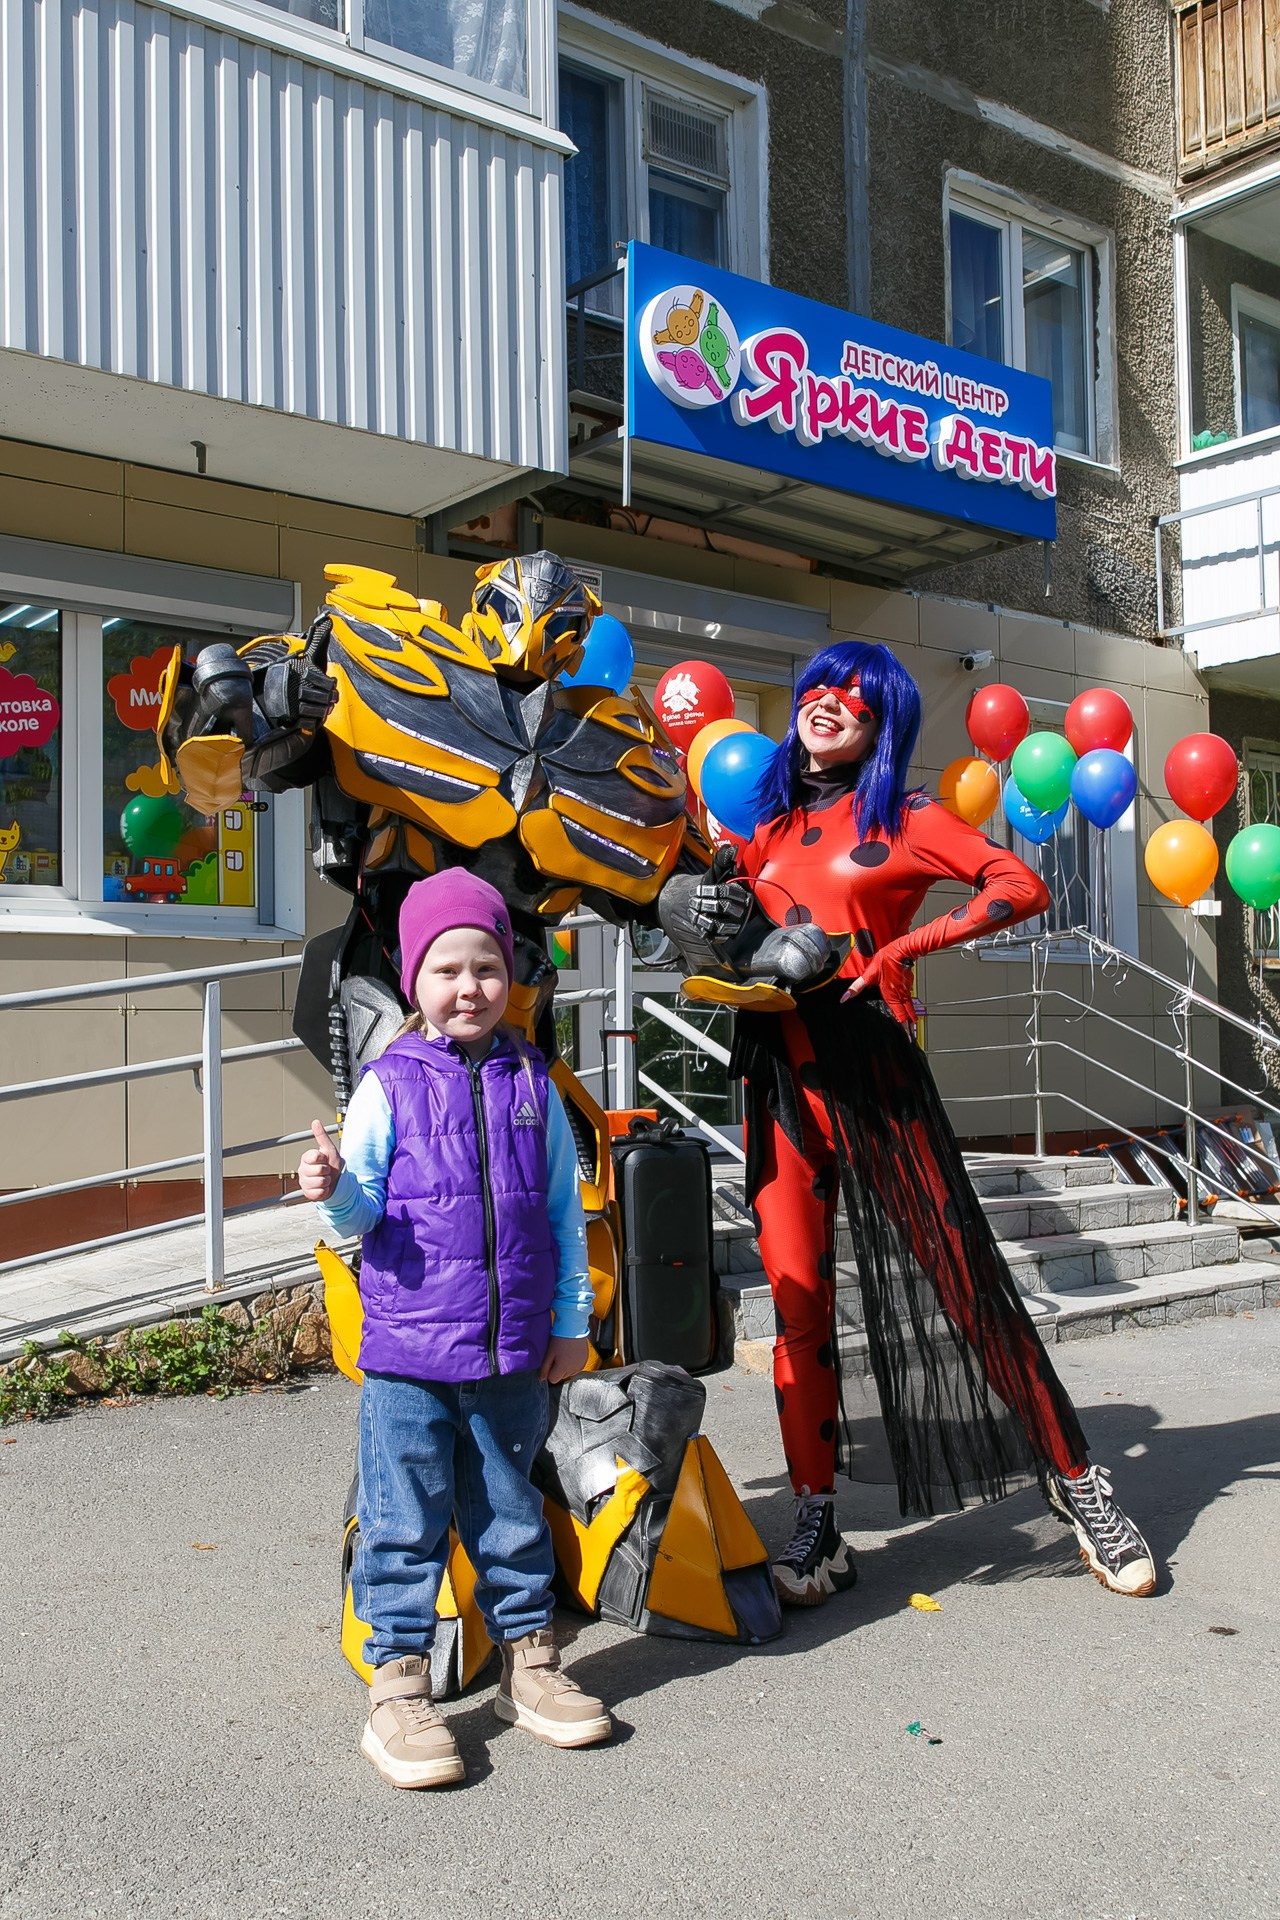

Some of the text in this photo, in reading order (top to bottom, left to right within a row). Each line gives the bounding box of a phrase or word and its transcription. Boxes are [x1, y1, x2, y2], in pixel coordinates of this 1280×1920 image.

[842, 343, 1007, 414] ДЕТСКИЙ ЦЕНТР
[0, 699, 52, 714] товка
[512, 1117, 540, 1126] addas
